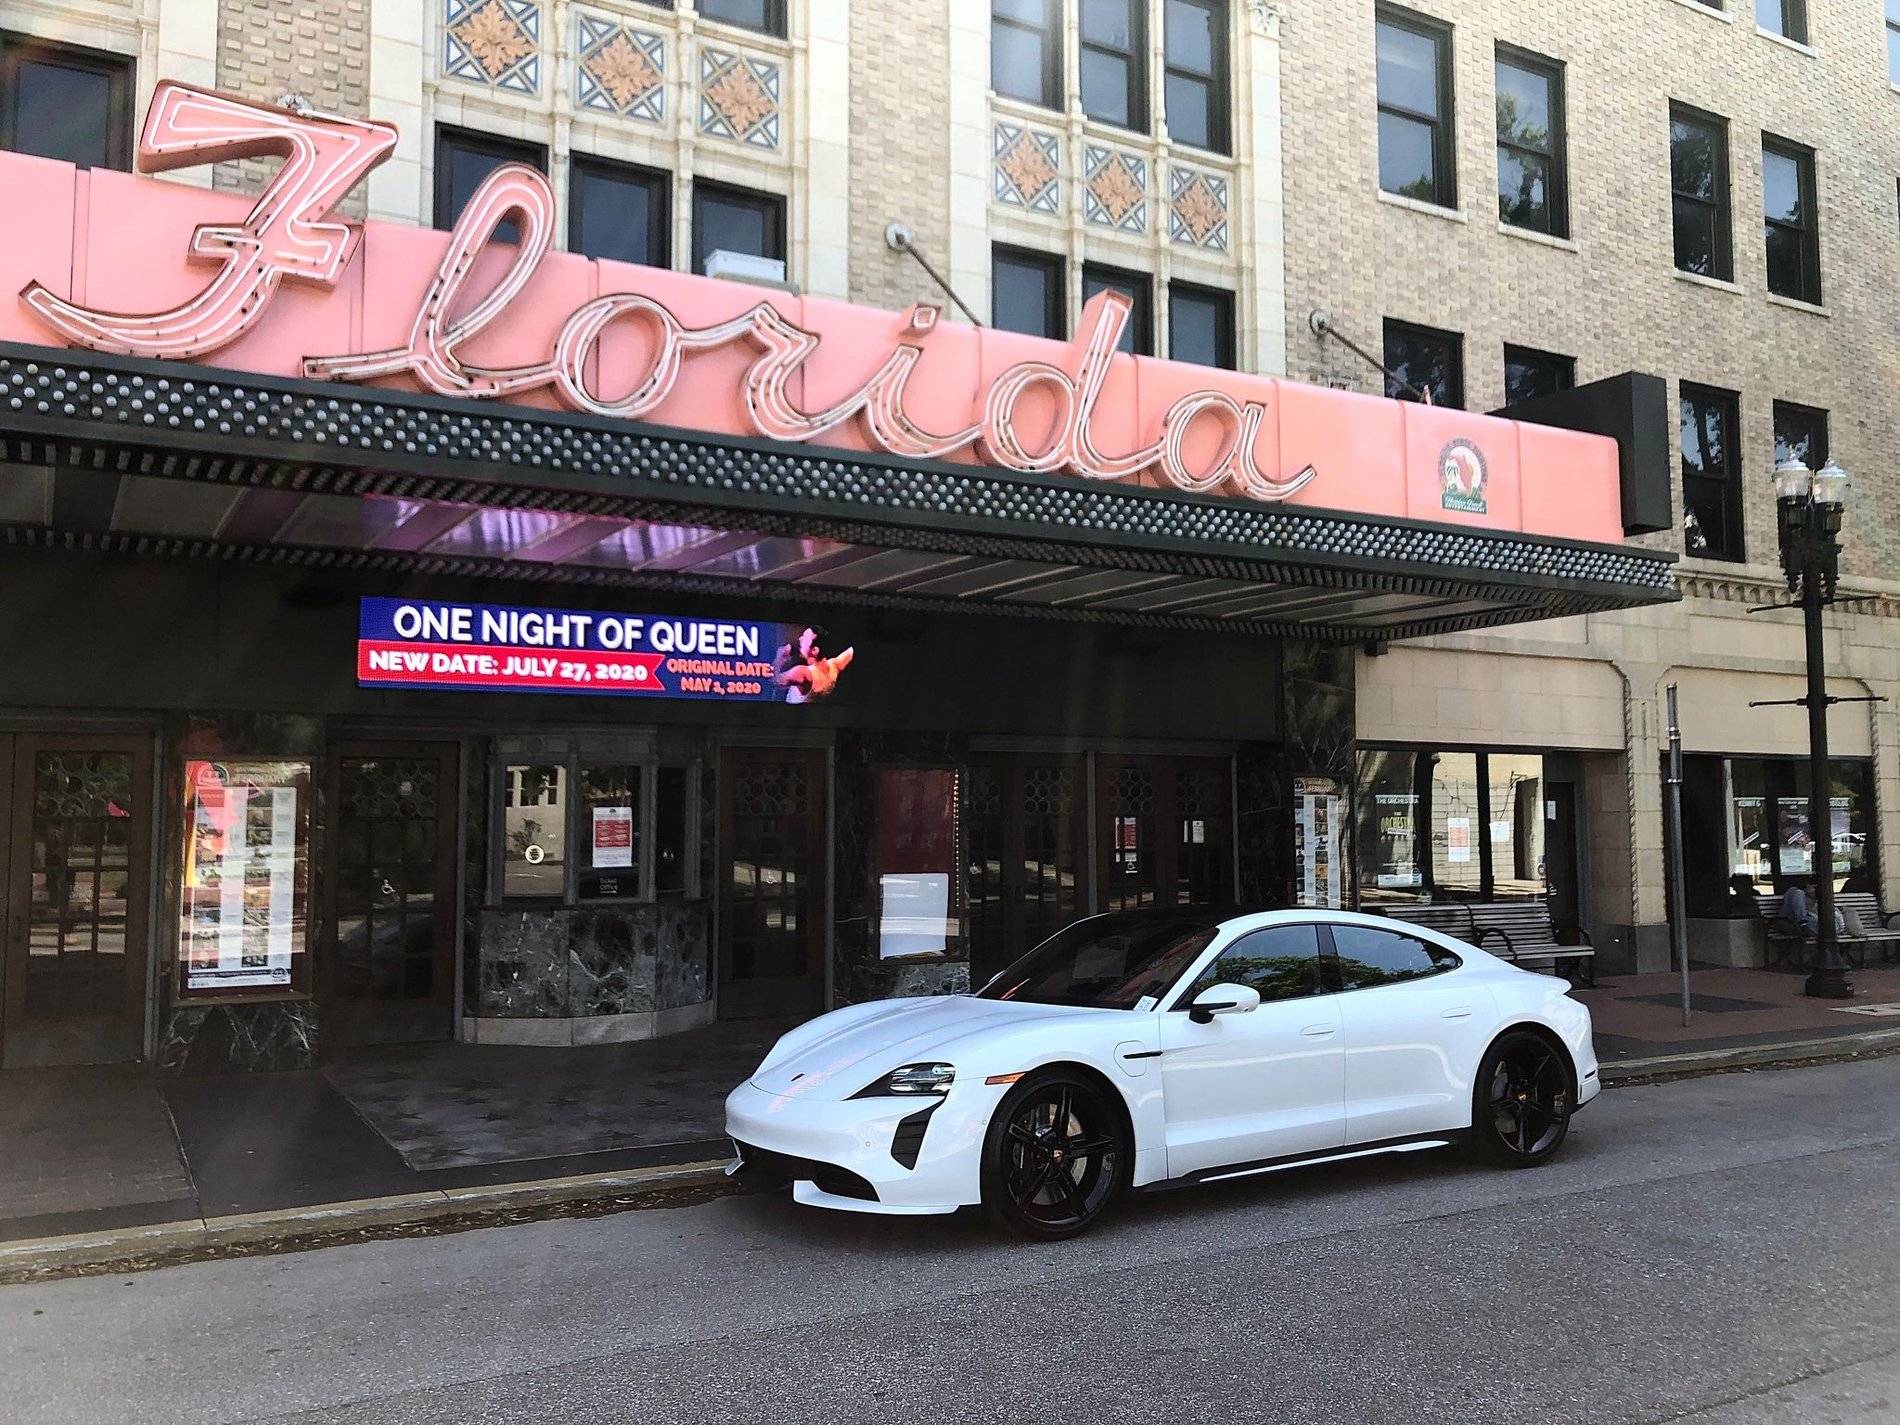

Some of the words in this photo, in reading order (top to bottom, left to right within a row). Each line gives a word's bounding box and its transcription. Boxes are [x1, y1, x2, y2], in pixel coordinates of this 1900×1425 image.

[18, 80, 1317, 503] Florida
[393, 605, 473, 642] ONE
[481, 609, 593, 648] NIGHT
[599, 617, 644, 650] OF
[650, 620, 759, 657] QUEEN
[369, 650, 430, 672] NEW
[432, 653, 499, 676] DATE:
[502, 656, 559, 677] JULY
[560, 662, 592, 682] 27,
[595, 663, 649, 681] 2020
[666, 658, 735, 676] ORIGINAL
[735, 661, 774, 678] DATE:
[681, 676, 713, 692] MAY
[713, 681, 726, 695] 1,
[727, 681, 762, 694] 2020
